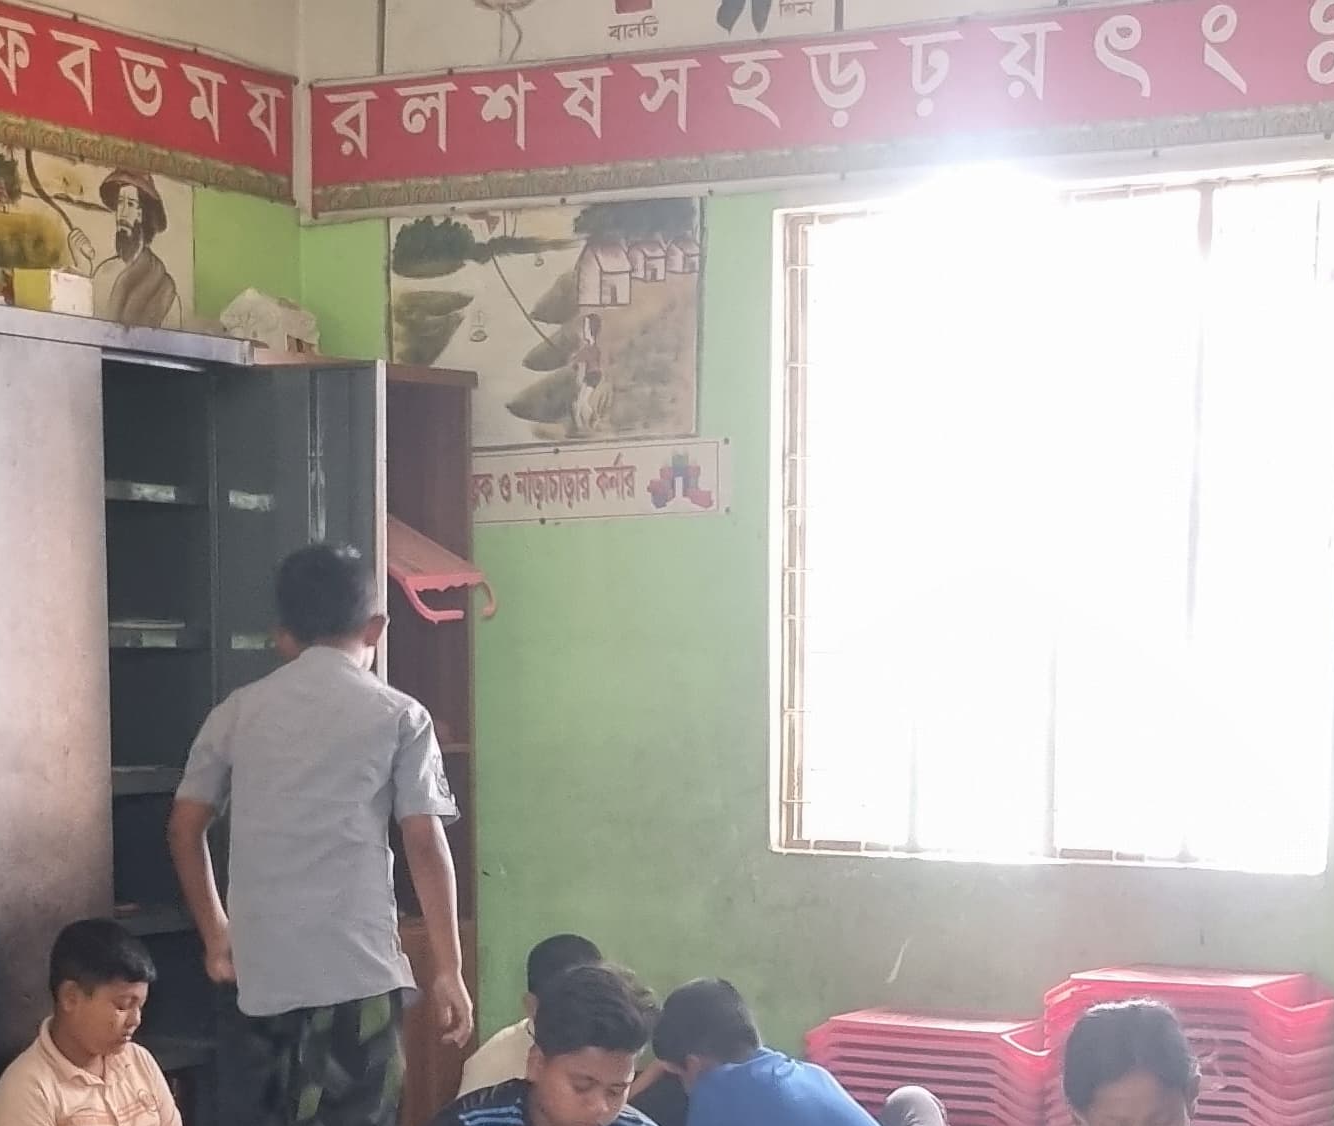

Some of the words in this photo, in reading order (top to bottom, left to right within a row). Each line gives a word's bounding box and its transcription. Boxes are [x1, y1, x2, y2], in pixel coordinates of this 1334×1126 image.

[608, 15, 659, 41] বালতি
[49, 29, 102, 116] ব
[115, 47, 168, 116] ভ
[180, 63, 227, 144] ম
[241, 80, 285, 156] য
[324, 92, 378, 159] র
[393, 82, 457, 153] ল
[471, 72, 537, 151] শ
[555, 67, 614, 138] ষ
[631, 59, 700, 133] স
[720, 50, 783, 129] হ
[801, 41, 878, 129] ড়
[898, 31, 964, 117] ঢ়
[989, 21, 1062, 100] য়
[1093, 14, 1151, 98] ৎ
[1201, 4, 1247, 95] ং
[499, 473, 512, 502] ও
